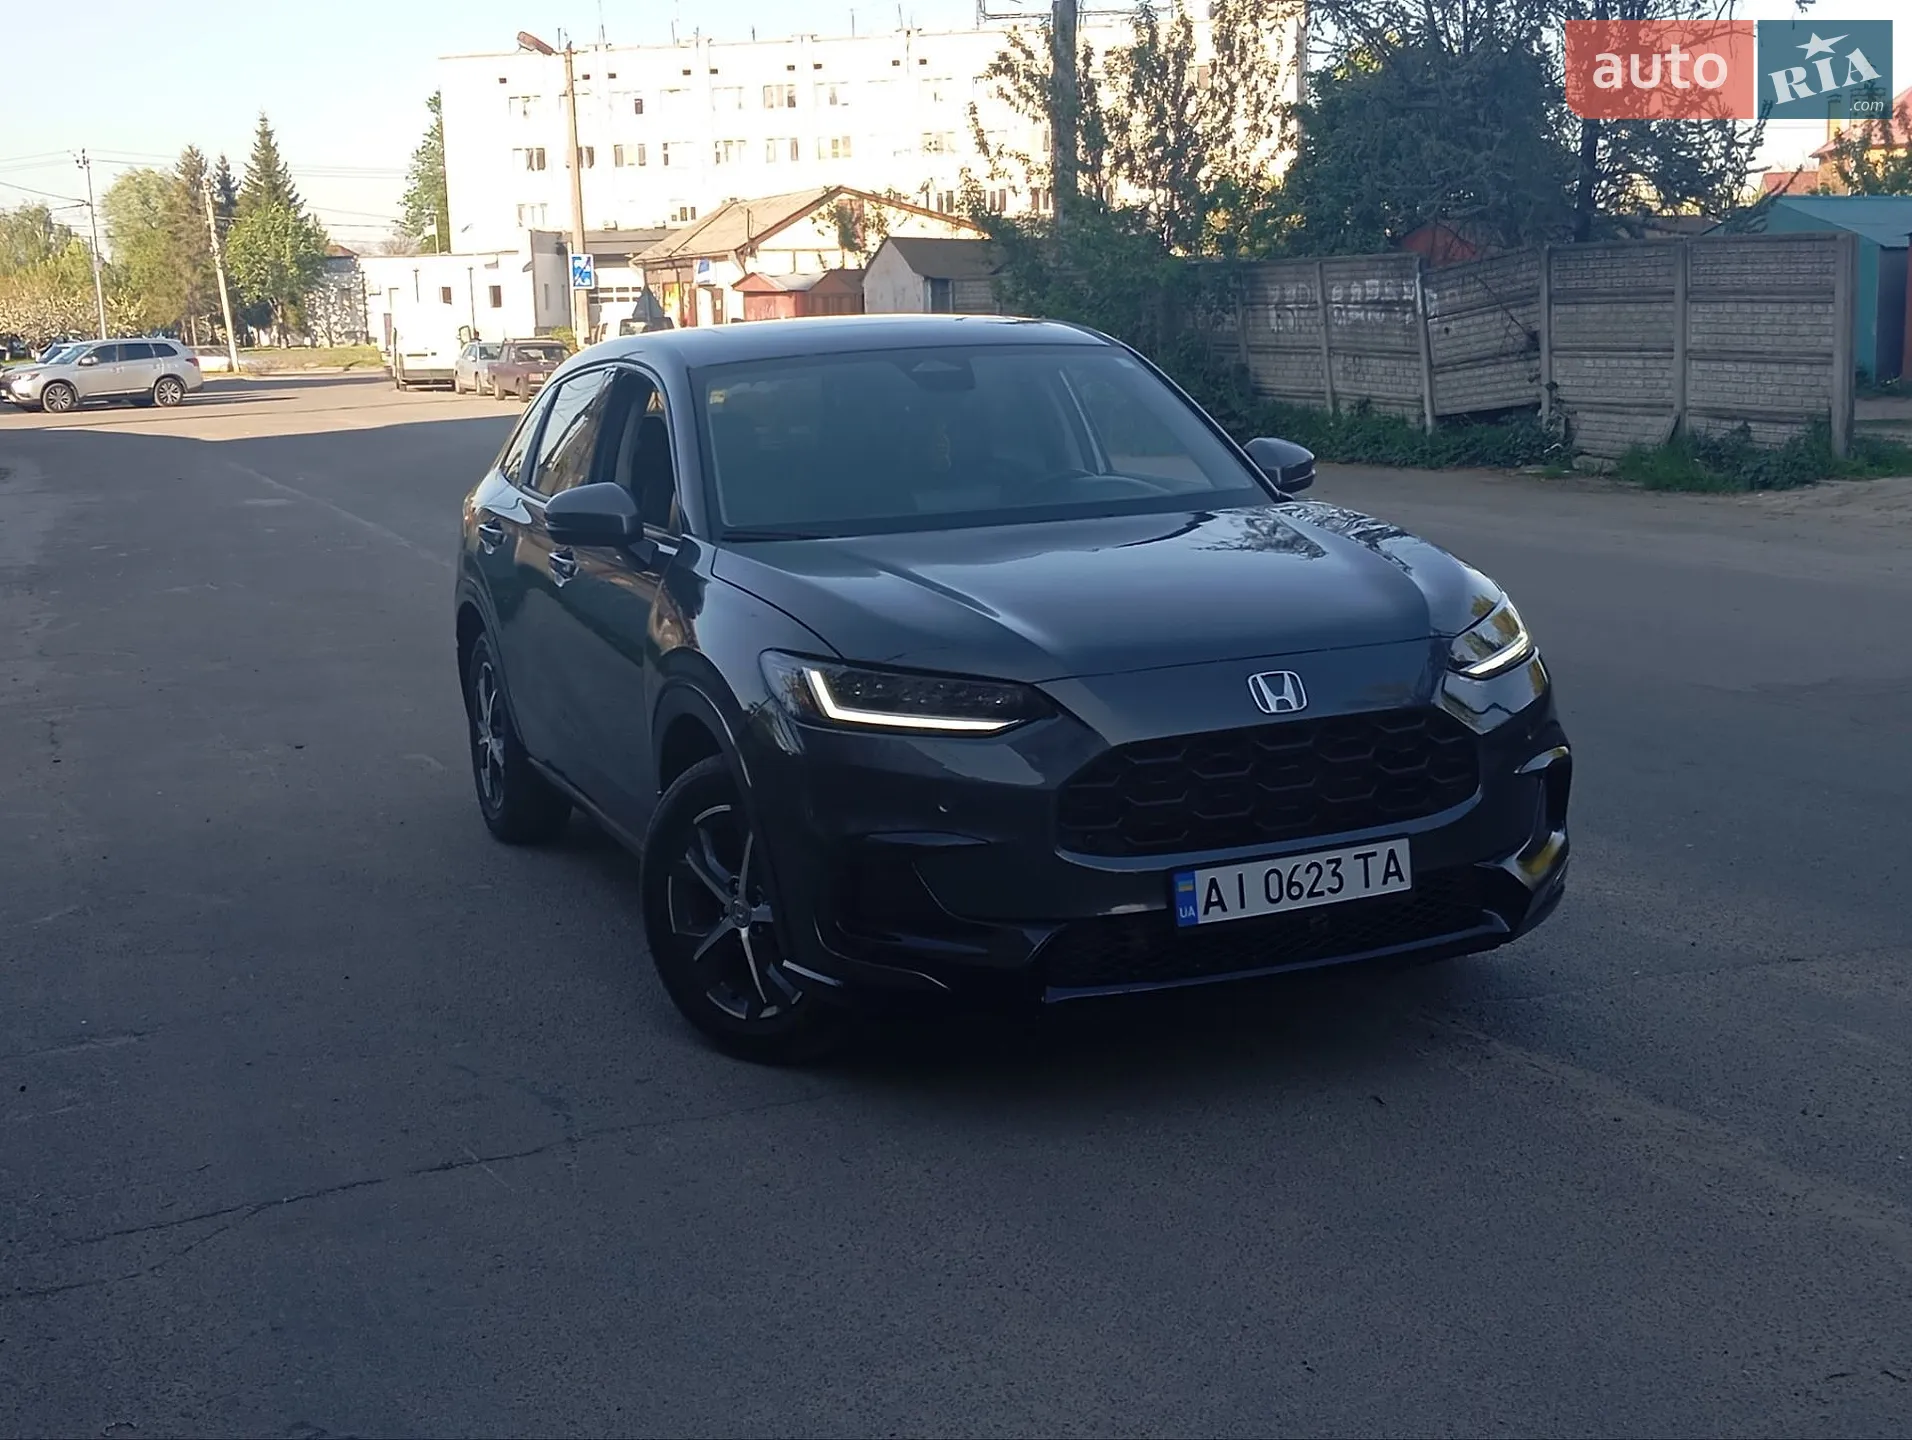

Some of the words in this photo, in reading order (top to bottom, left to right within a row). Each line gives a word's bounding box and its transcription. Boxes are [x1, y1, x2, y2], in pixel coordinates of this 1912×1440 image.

[1202, 873, 1246, 915] AI
[1264, 857, 1344, 904] 0623
[1353, 848, 1405, 889] TA
[1179, 906, 1196, 918] UA
